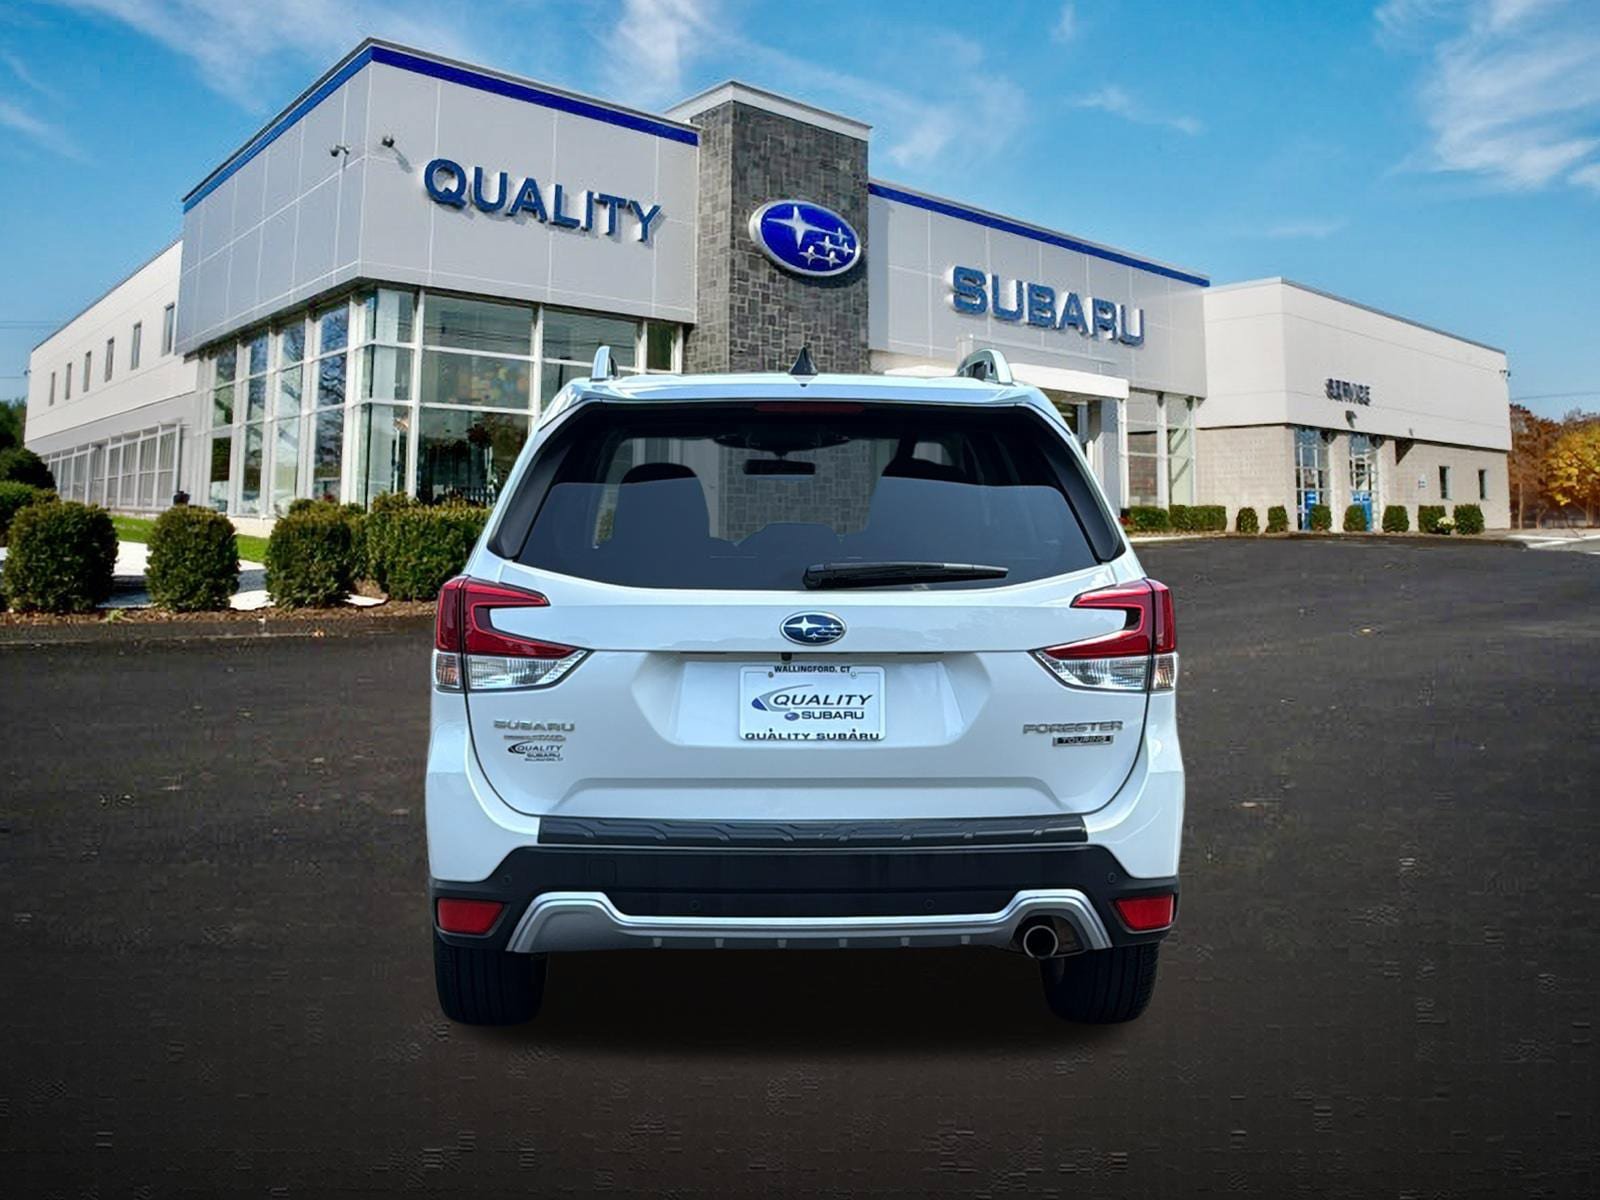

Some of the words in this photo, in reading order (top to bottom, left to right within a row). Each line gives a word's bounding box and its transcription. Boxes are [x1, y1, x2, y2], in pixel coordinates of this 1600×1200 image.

[424, 158, 662, 243] QUALITY
[950, 265, 1145, 347] SUBARU
[1325, 378, 1371, 406] SERVICE
[840, 665, 851, 673] CT
[773, 694, 873, 706] QUALITY
[801, 711, 865, 720] SUBARU
[493, 720, 575, 732] SUBARU
[1023, 720, 1124, 734] FORESTER
[745, 732, 811, 741] QUALITY
[816, 732, 880, 741] SUBARU
[516, 744, 563, 752] QUALITY
